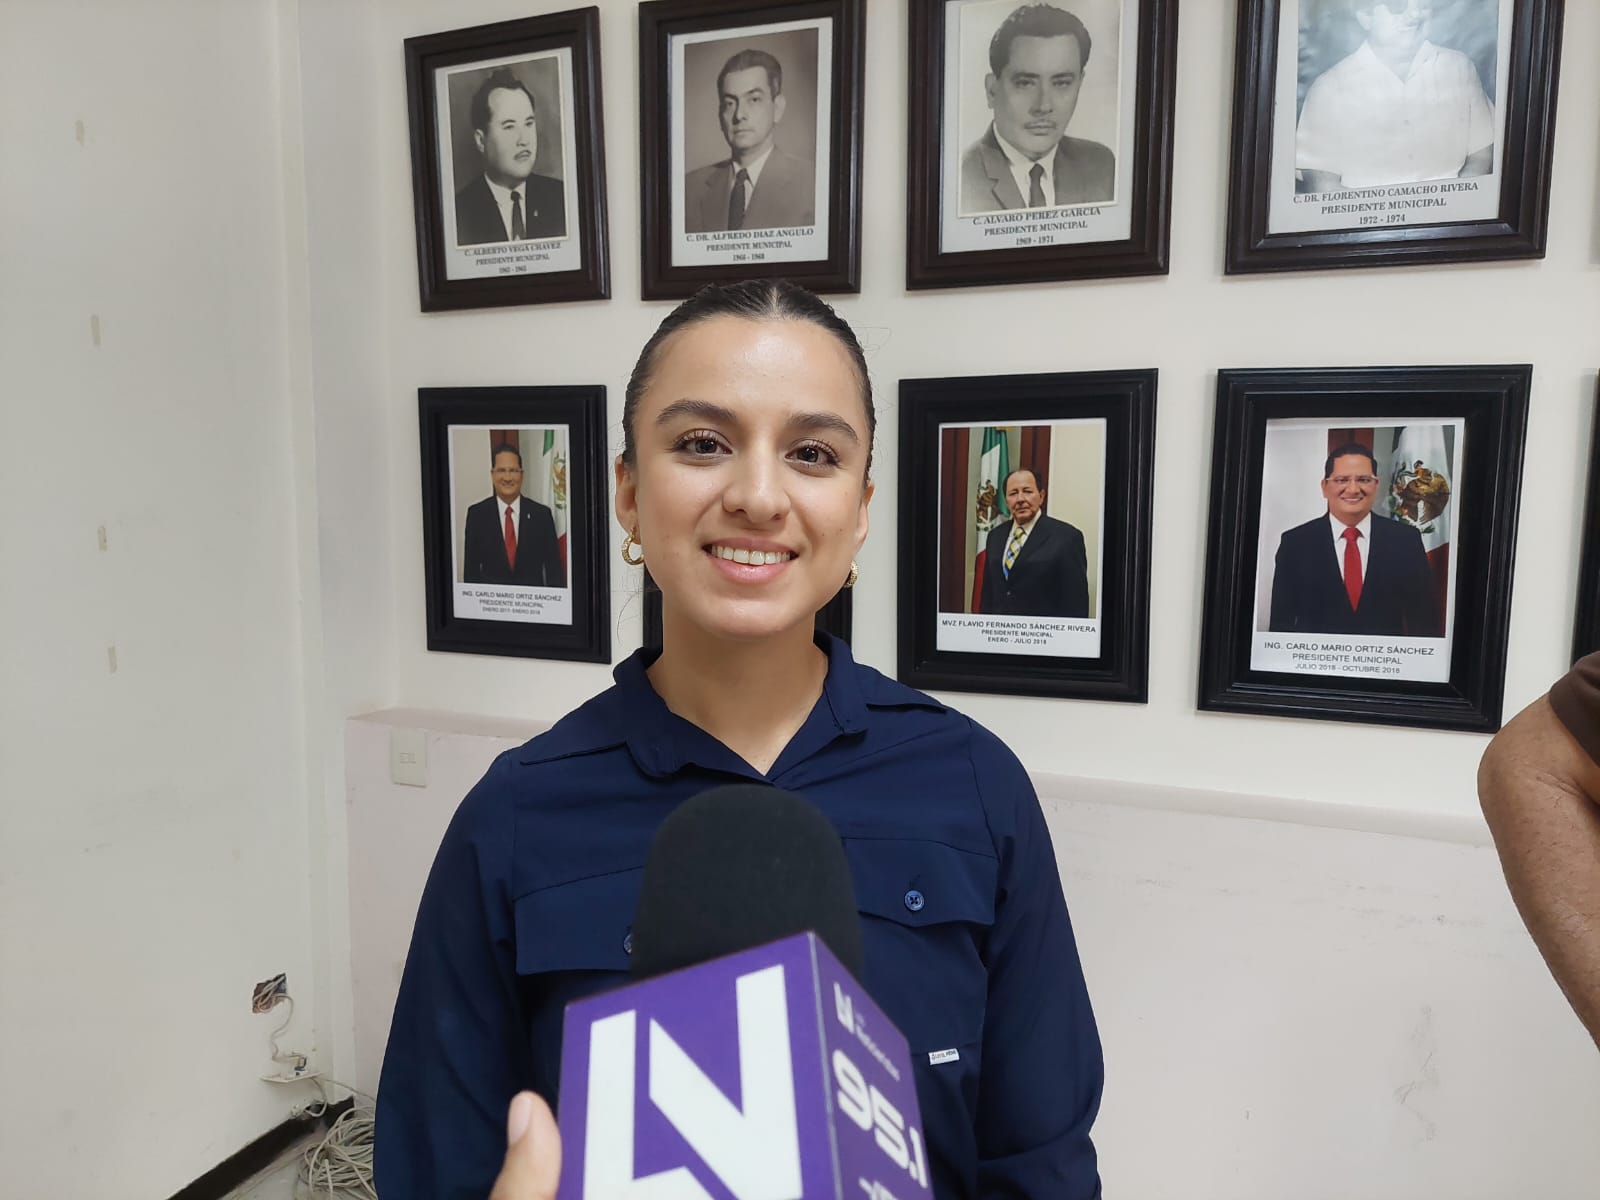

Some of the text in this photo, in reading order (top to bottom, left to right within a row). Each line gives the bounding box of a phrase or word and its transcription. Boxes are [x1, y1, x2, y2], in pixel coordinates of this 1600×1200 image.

[1293, 182, 1478, 204] C. DR. FLORENTINO CAMACHO RIVERA
[1321, 198, 1447, 214] PRESIDENTE MUNICIPAL
[984, 214, 1023, 224] ALVARO
[1359, 216, 1378, 224] 1972
[1387, 214, 1406, 223] 1974
[984, 221, 1088, 236] PRESIDENTE MUNICIPAL
[711, 232, 750, 241] ALFREDO
[776, 228, 814, 237] ANGULO
[1038, 236, 1054, 244] 1971
[473, 247, 507, 256] ALBERTO
[706, 241, 792, 251] PRESIDENTE MUNICIPAL
[476, 254, 550, 265] PRESIDENTE MUNICIPAL
[958, 620, 984, 628] FLAVIO
[986, 621, 1027, 630] FERNANDO
[1067, 624, 1096, 632] RIVERA
[1286, 642, 1318, 651] CARLO
[1321, 644, 1352, 652] MARIO
[1355, 645, 1384, 653] ORTIZ
[1387, 645, 1434, 656] SÁNCHEZ
[1292, 653, 1402, 664] PRESIDENTE MUNICIPAL
[832, 1049, 928, 1189] 95.1
